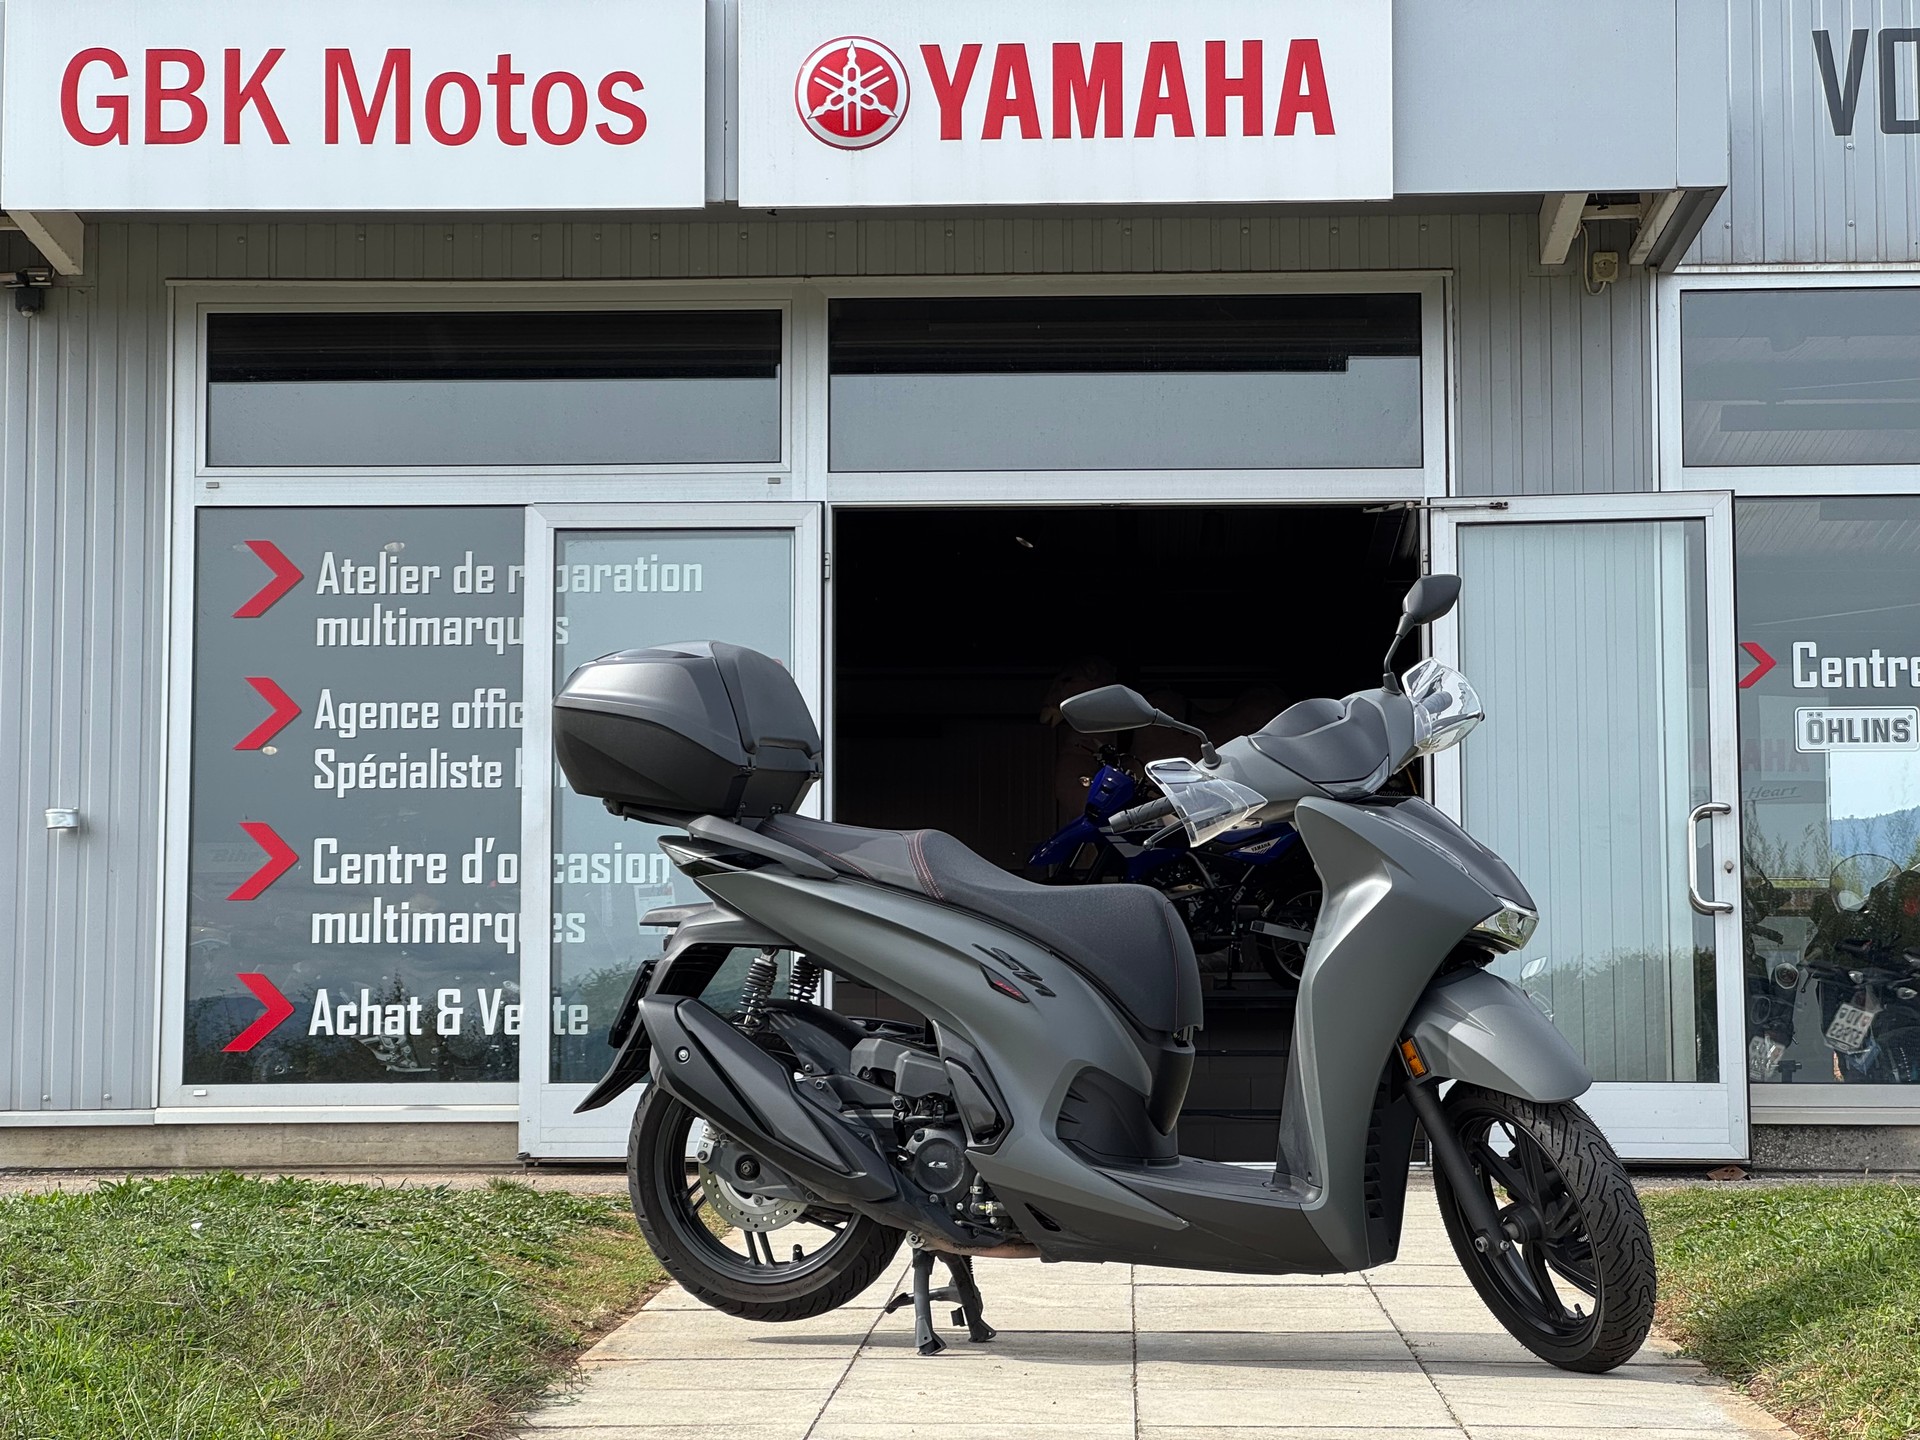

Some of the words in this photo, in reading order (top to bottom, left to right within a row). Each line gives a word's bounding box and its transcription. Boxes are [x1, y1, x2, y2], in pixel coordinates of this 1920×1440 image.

[60, 47, 290, 146] GBK
[323, 47, 648, 146] Motos
[919, 38, 1336, 141] YAMAHA
[316, 551, 441, 595] Atelier
[453, 551, 495, 594] de
[508, 554, 703, 593] rparation
[316, 603, 569, 655] multimarqus
[314, 688, 440, 738] Agence
[314, 748, 502, 798] Spécialiste
[313, 838, 447, 884] Centre
[461, 837, 670, 884] d'ocasion
[311, 897, 586, 953] multimarqs
[308, 988, 422, 1036] Achat
[436, 988, 464, 1036] &
[477, 988, 589, 1036] Vete
